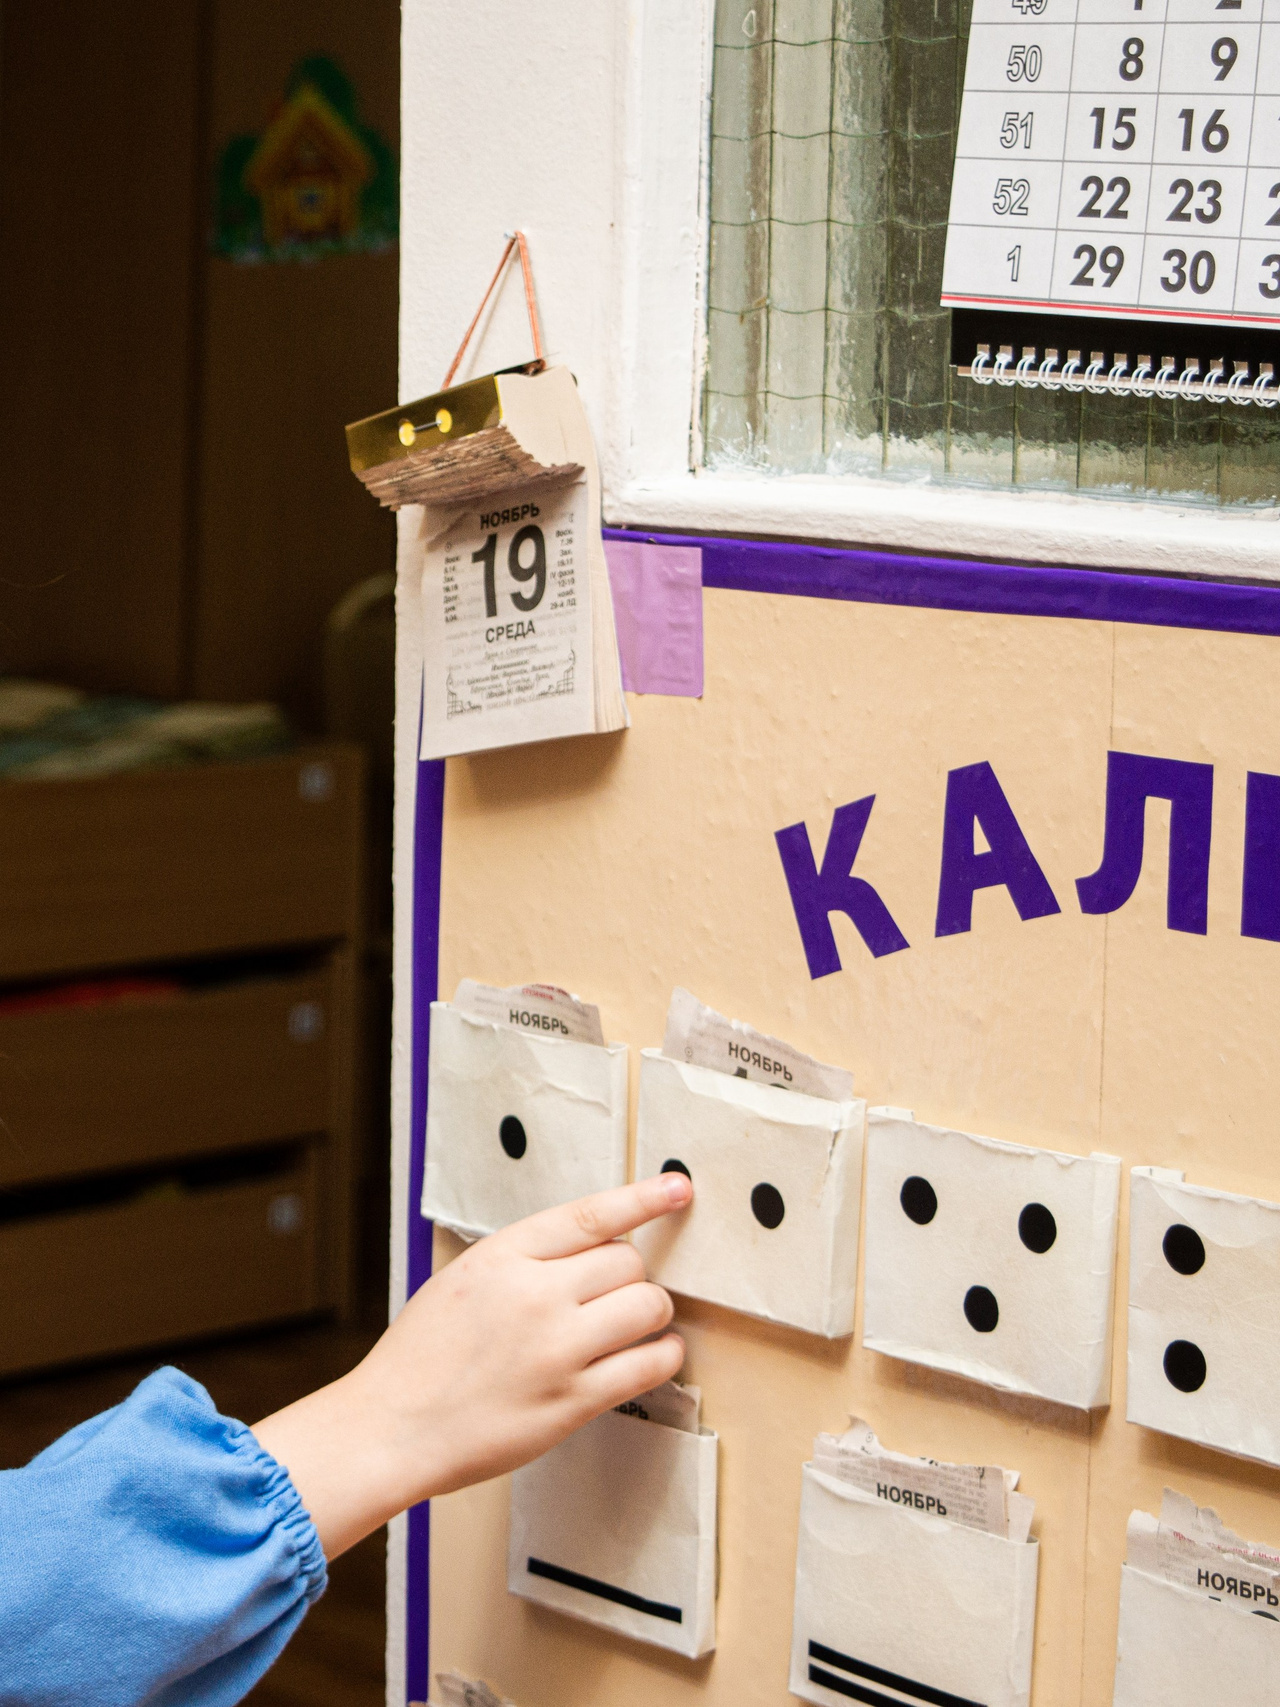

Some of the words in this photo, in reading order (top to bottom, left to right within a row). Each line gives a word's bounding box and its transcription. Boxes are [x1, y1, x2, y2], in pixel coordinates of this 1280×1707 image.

[1006, 45, 1042, 83] 50
[1119, 37, 1145, 81] 8
[1211, 36, 1238, 81] 9
[999, 111, 1034, 149] 51
[1089, 107, 1137, 151] 15
[1178, 108, 1230, 153] 16
[992, 178, 1030, 216] 52
[1077, 175, 1131, 219] 22
[1165, 178, 1221, 224] 23
[1006, 245, 1022, 282] 1
[1070, 244, 1124, 288] 29
[1160, 248, 1216, 294] 30
[480, 503, 541, 530] НОЯБРЬ
[471, 524, 547, 618] 19
[485, 620, 536, 643] СРЕДА
[509, 1009, 569, 1035] НОЯБРЬ
[728, 1042, 793, 1082] НОЯБРЬ
[877, 1482, 947, 1516] НОЯБРЬ
[1197, 1568, 1279, 1607] НОЯБРЬ
